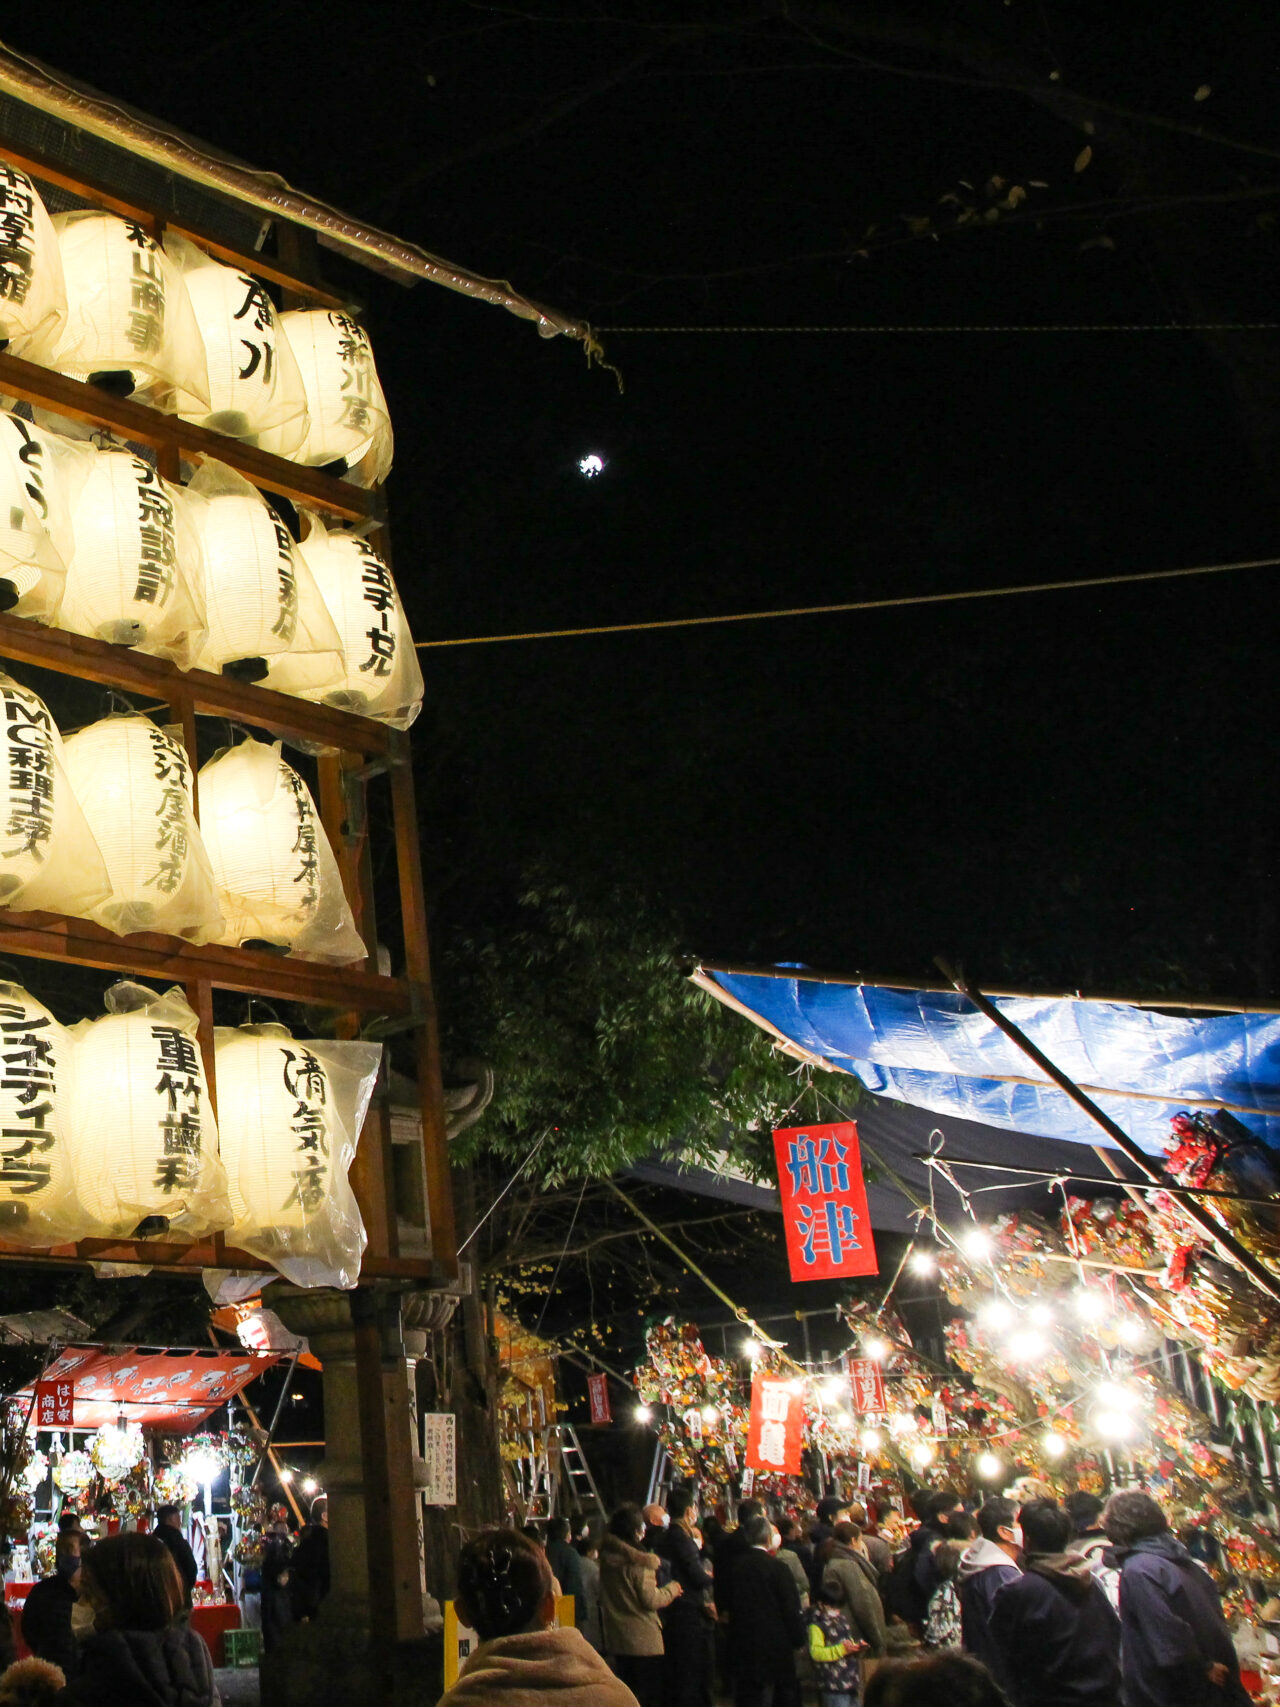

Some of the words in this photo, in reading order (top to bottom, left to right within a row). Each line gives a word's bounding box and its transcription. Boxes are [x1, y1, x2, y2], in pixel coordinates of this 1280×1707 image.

[151, 1026, 202, 1195] 重竹歯科
[786, 1130, 862, 1265] 船津
[41, 1394, 55, 1424] 商店
[57, 1384, 70, 1422] はし家
[857, 1361, 881, 1411] 福田屋
